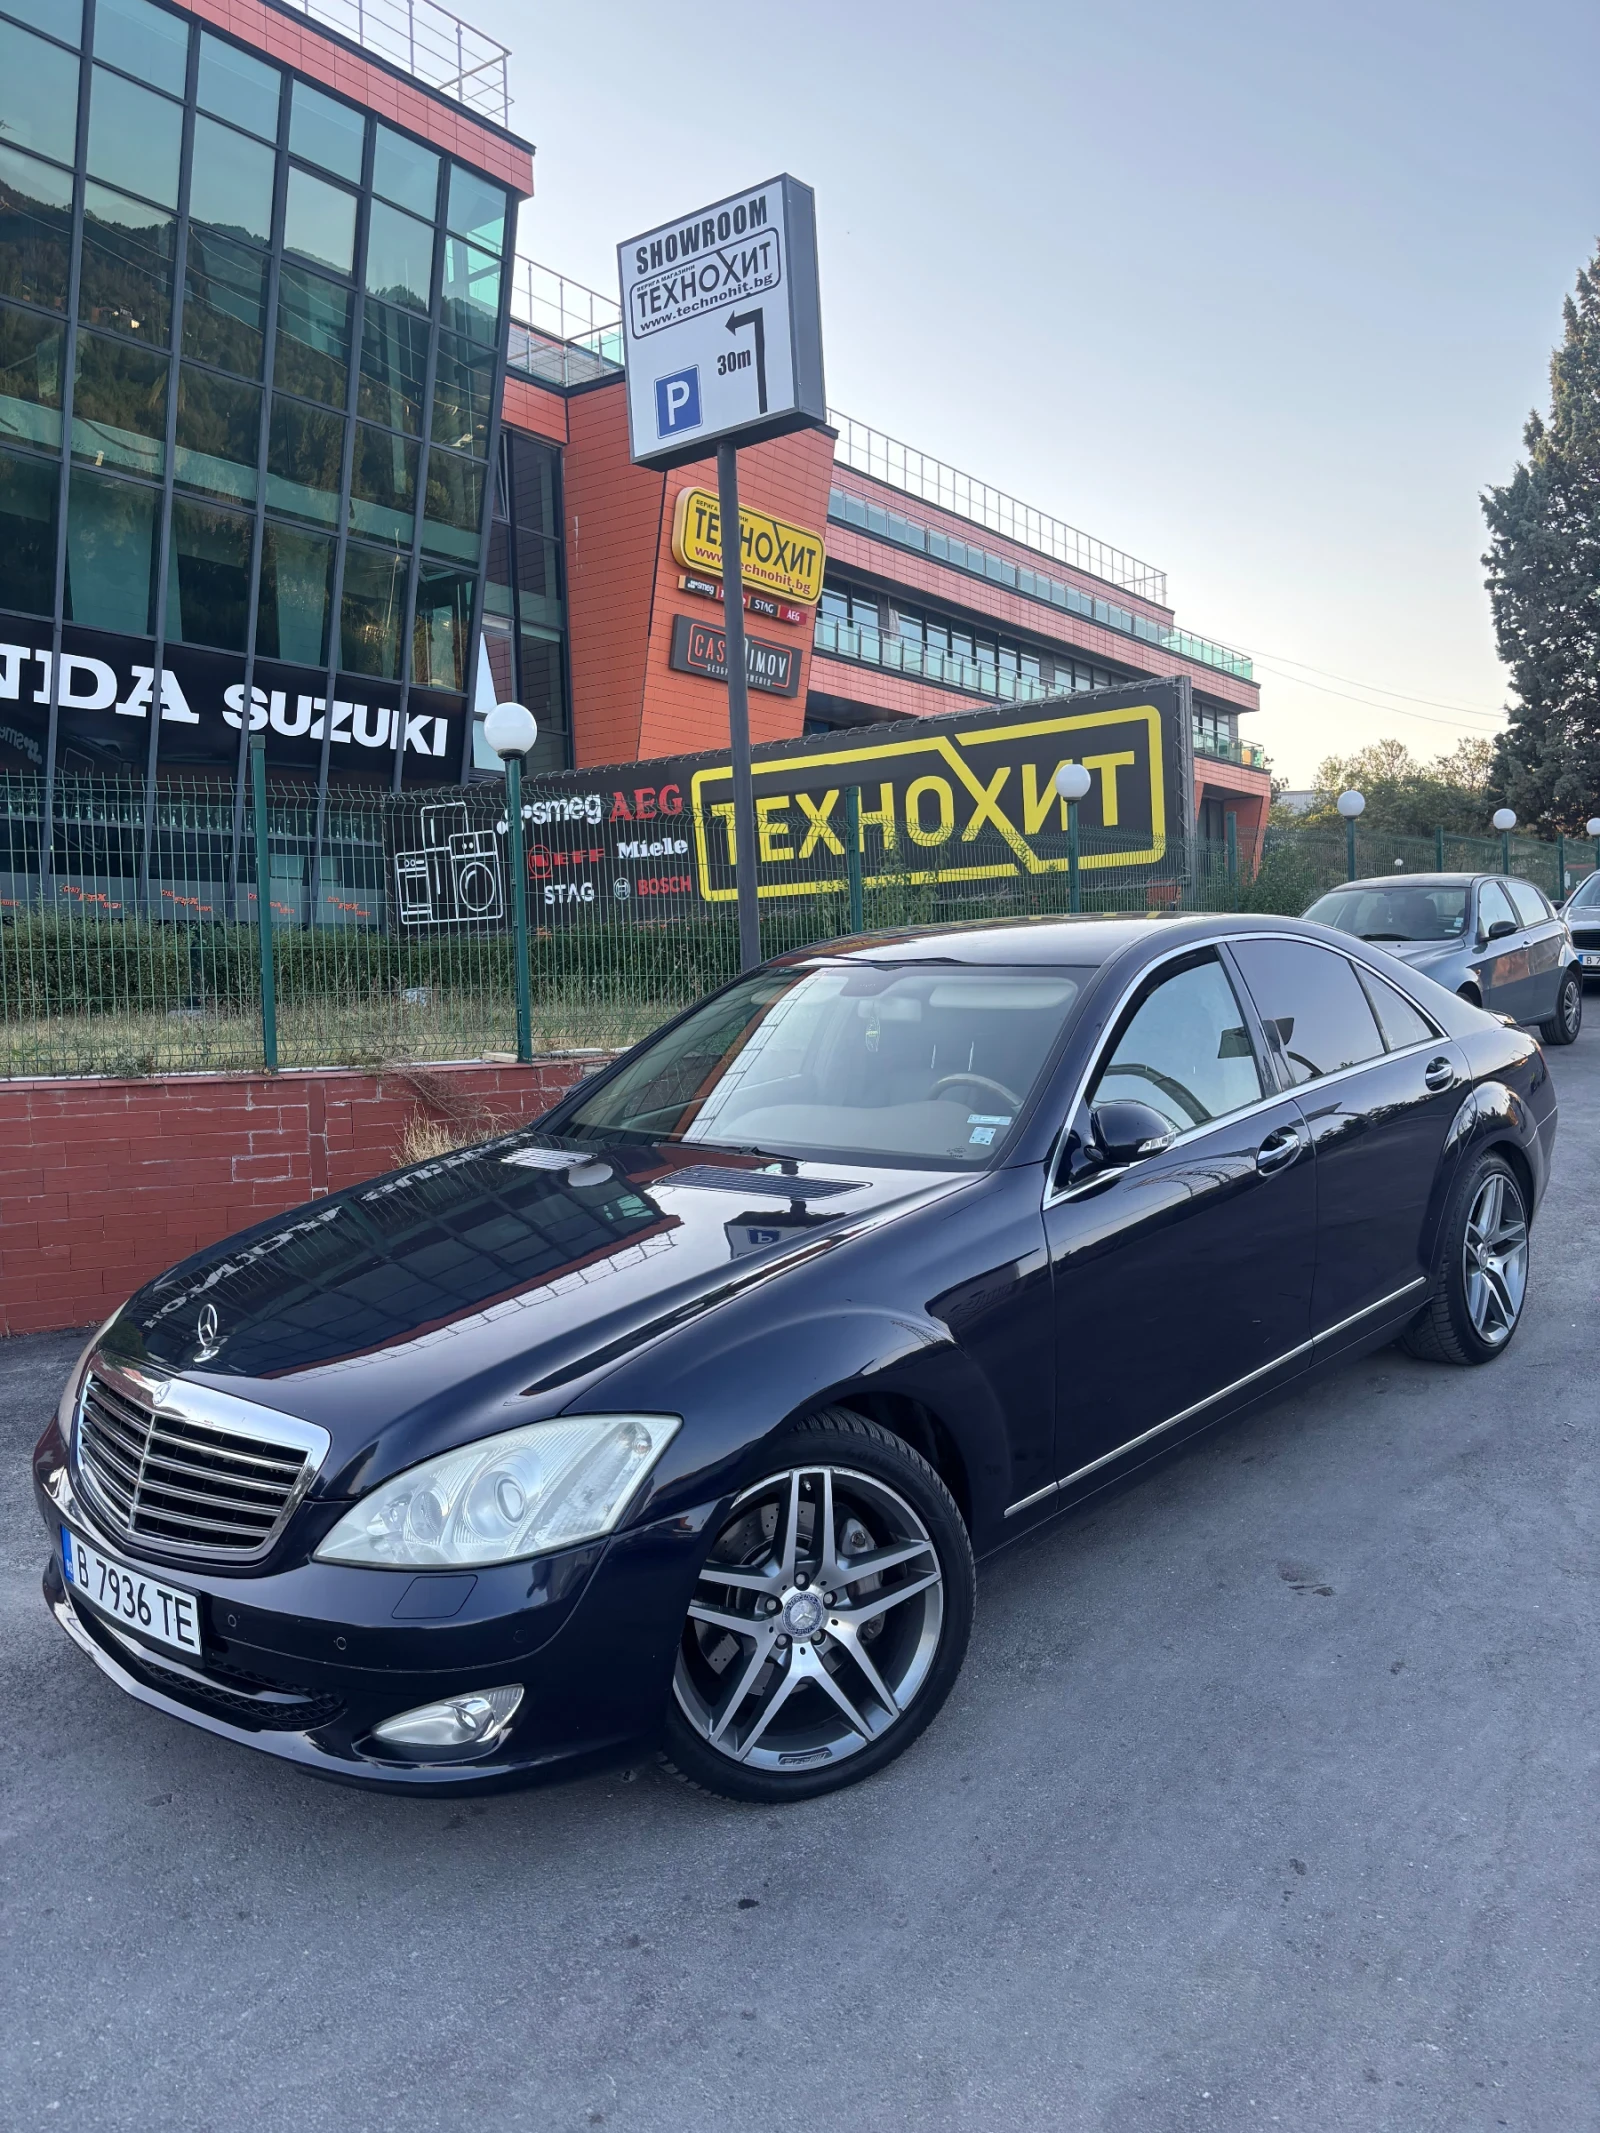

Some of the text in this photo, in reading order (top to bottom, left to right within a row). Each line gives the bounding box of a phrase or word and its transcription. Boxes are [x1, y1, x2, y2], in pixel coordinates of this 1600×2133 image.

[636, 195, 768, 275] SHOWROOM
[637, 241, 771, 318] ТЕХНОХИТ
[640, 273, 773, 332] www.technohit.bg
[717, 349, 751, 377] 30m
[667, 380, 690, 426] P
[695, 506, 816, 578] ТЕНОХИТ
[754, 599, 774, 614] STAG
[786, 609, 800, 621] AEG
[222, 683, 448, 757] SUZUKI
[533, 784, 684, 825] smeg AEG
[711, 740, 1135, 868] ТЕХНОХИТ
[617, 837, 689, 860] Miele
[544, 875, 691, 905] STAG BOSCH
[77, 1543, 195, 1647] B 7936 TE
